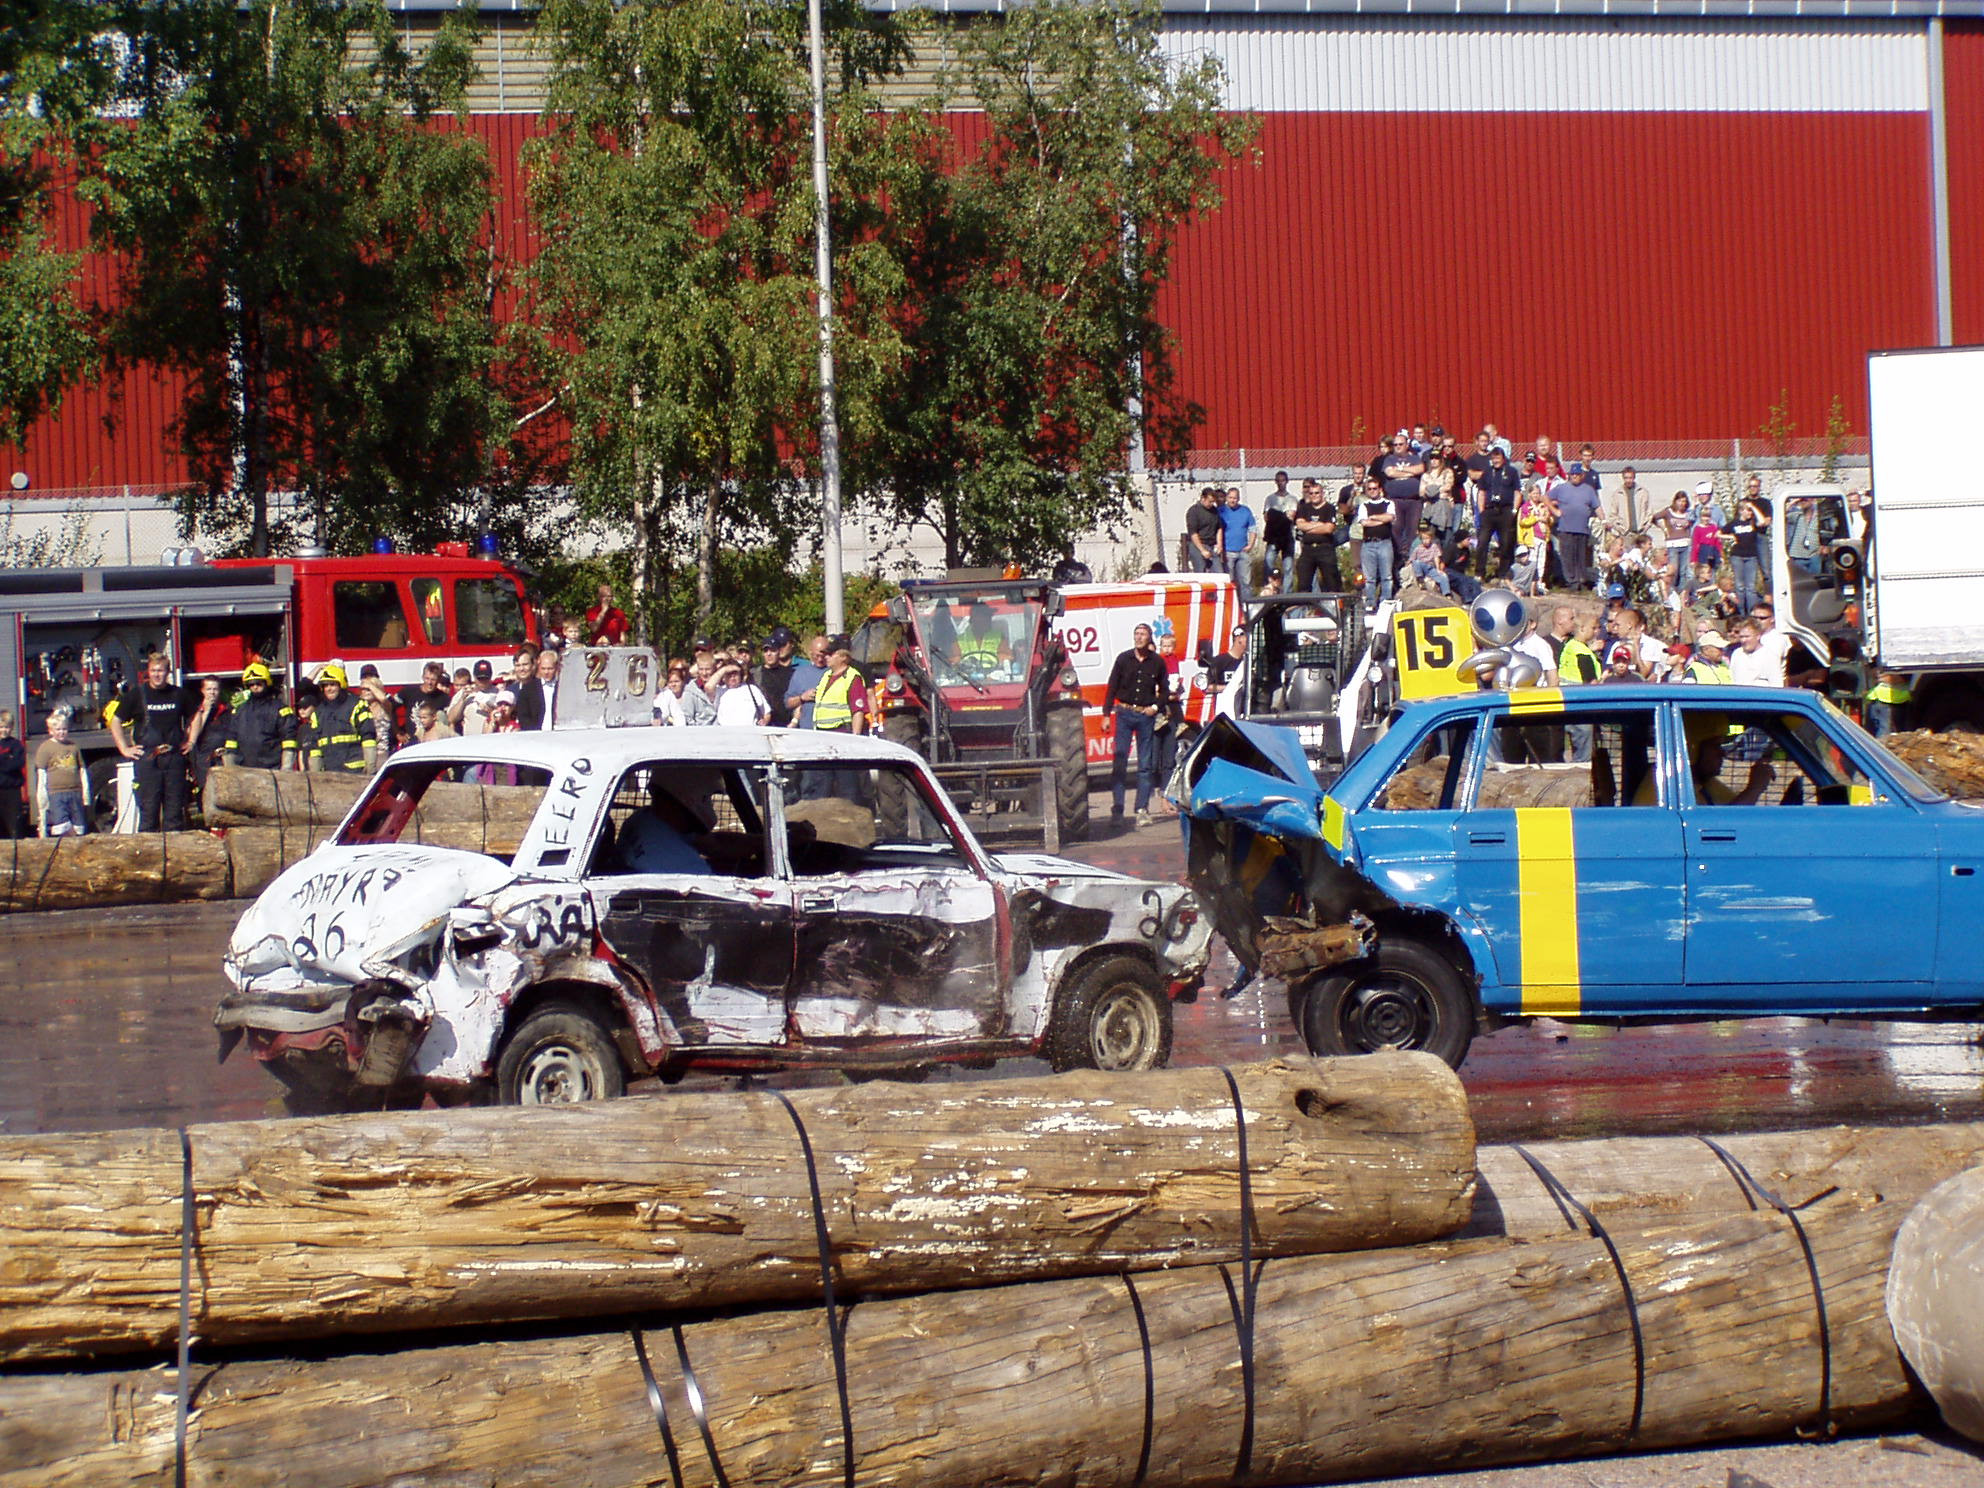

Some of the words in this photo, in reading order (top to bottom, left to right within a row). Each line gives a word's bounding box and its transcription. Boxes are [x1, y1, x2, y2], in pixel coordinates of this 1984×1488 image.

[1397, 616, 1454, 671] 15
[585, 651, 649, 697] 26
[545, 758, 593, 845] EERO
[293, 910, 345, 962] 26
